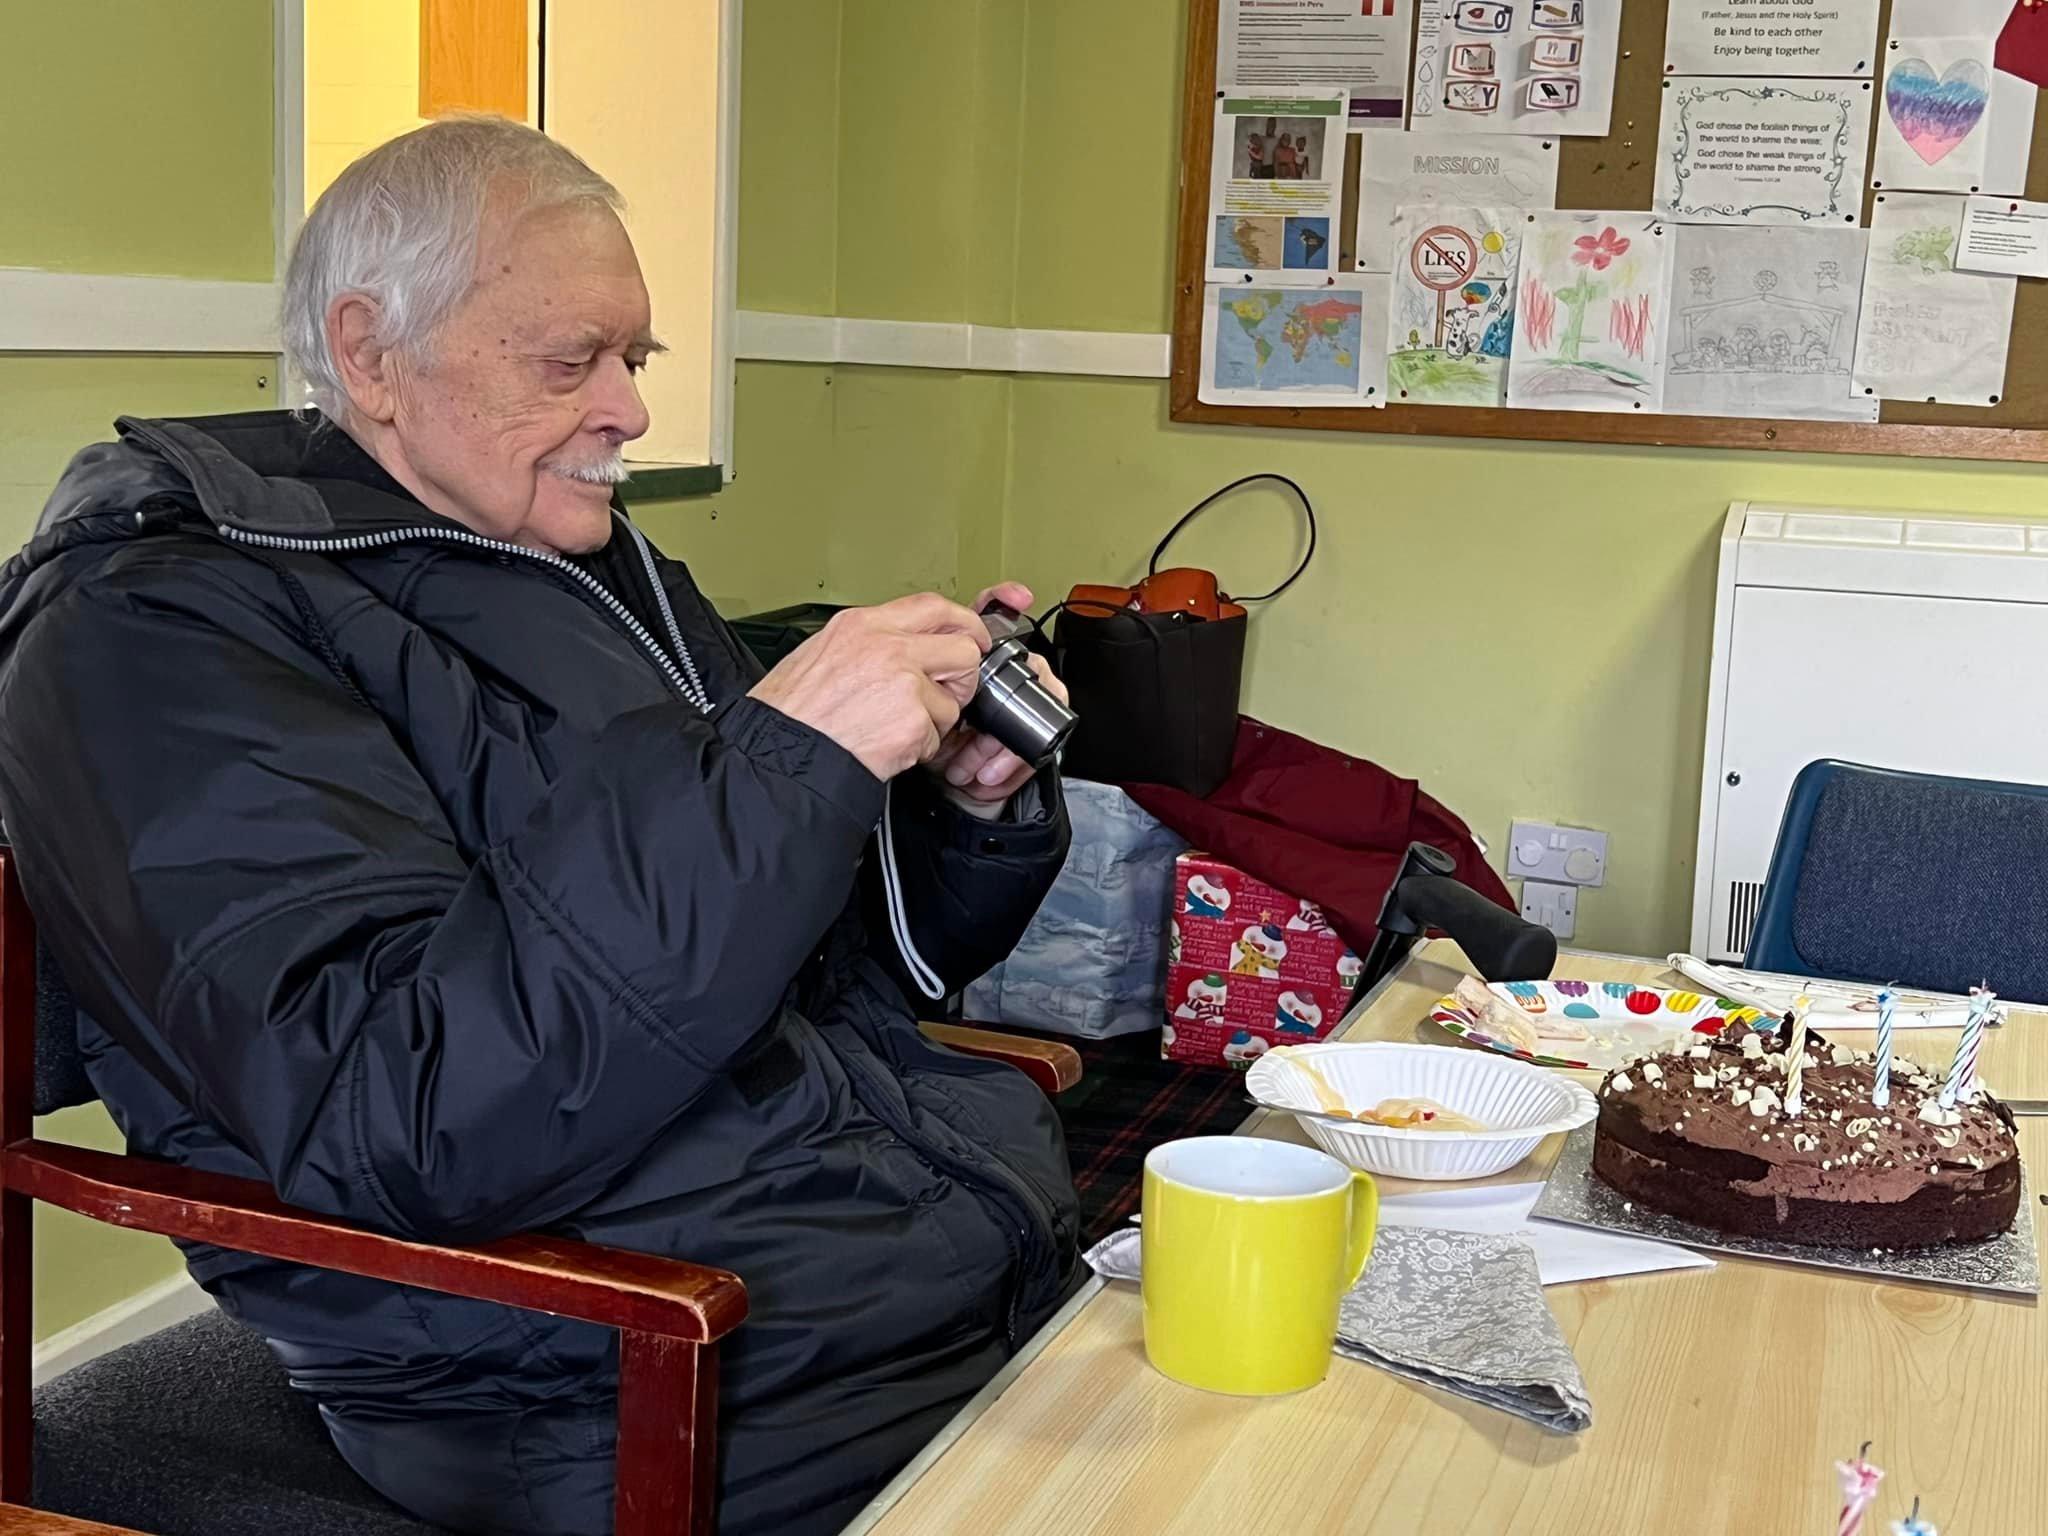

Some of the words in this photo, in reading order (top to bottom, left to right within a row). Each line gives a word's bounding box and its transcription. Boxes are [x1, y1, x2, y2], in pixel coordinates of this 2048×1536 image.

[1570, 2, 1580, 22] R
[1735, 11, 1757, 19] Jesus
[1759, 11, 1775, 19] and
[1776, 11, 1790, 19] the
[1792, 11, 1812, 20] Holy
[1714, 27, 1727, 36] Be
[1730, 27, 1751, 36] kind
[1754, 28, 1765, 36] to
[1767, 27, 1792, 36] each
[1794, 27, 1823, 37] other
[1714, 45, 1742, 56] Enjoy
[1744, 45, 1773, 57] being
[1775, 46, 1820, 57] together
[1482, 87, 1495, 106] Y
[1565, 85, 1574, 104] T
[1695, 121, 1714, 130] God
[1716, 122, 1742, 130] chose
[1744, 122, 1758, 130] the
[1760, 122, 1790, 131] foolish
[1791, 123, 1818, 133] things
[1820, 124, 1830, 132] of
[1715, 135, 1739, 143] world
[1741, 135, 1750, 143] to
[1751, 136, 1782, 144] shame
[1783, 136, 1798, 144] the
[1697, 149, 1716, 158] God
[1718, 150, 1744, 158] chose
[1746, 150, 1760, 158] the
[1762, 151, 1785, 159] weak
[1787, 151, 1814, 162] things
[1816, 152, 1826, 160] of
[1413, 155, 1500, 175] MISSION
[1693, 162, 1707, 170] the
[1735, 163, 1744, 171] to
[1745, 163, 1776, 172] shame
[1777, 164, 1792, 172] the
[1794, 164, 1822, 174] strong
[1424, 250, 1466, 266] LIES
